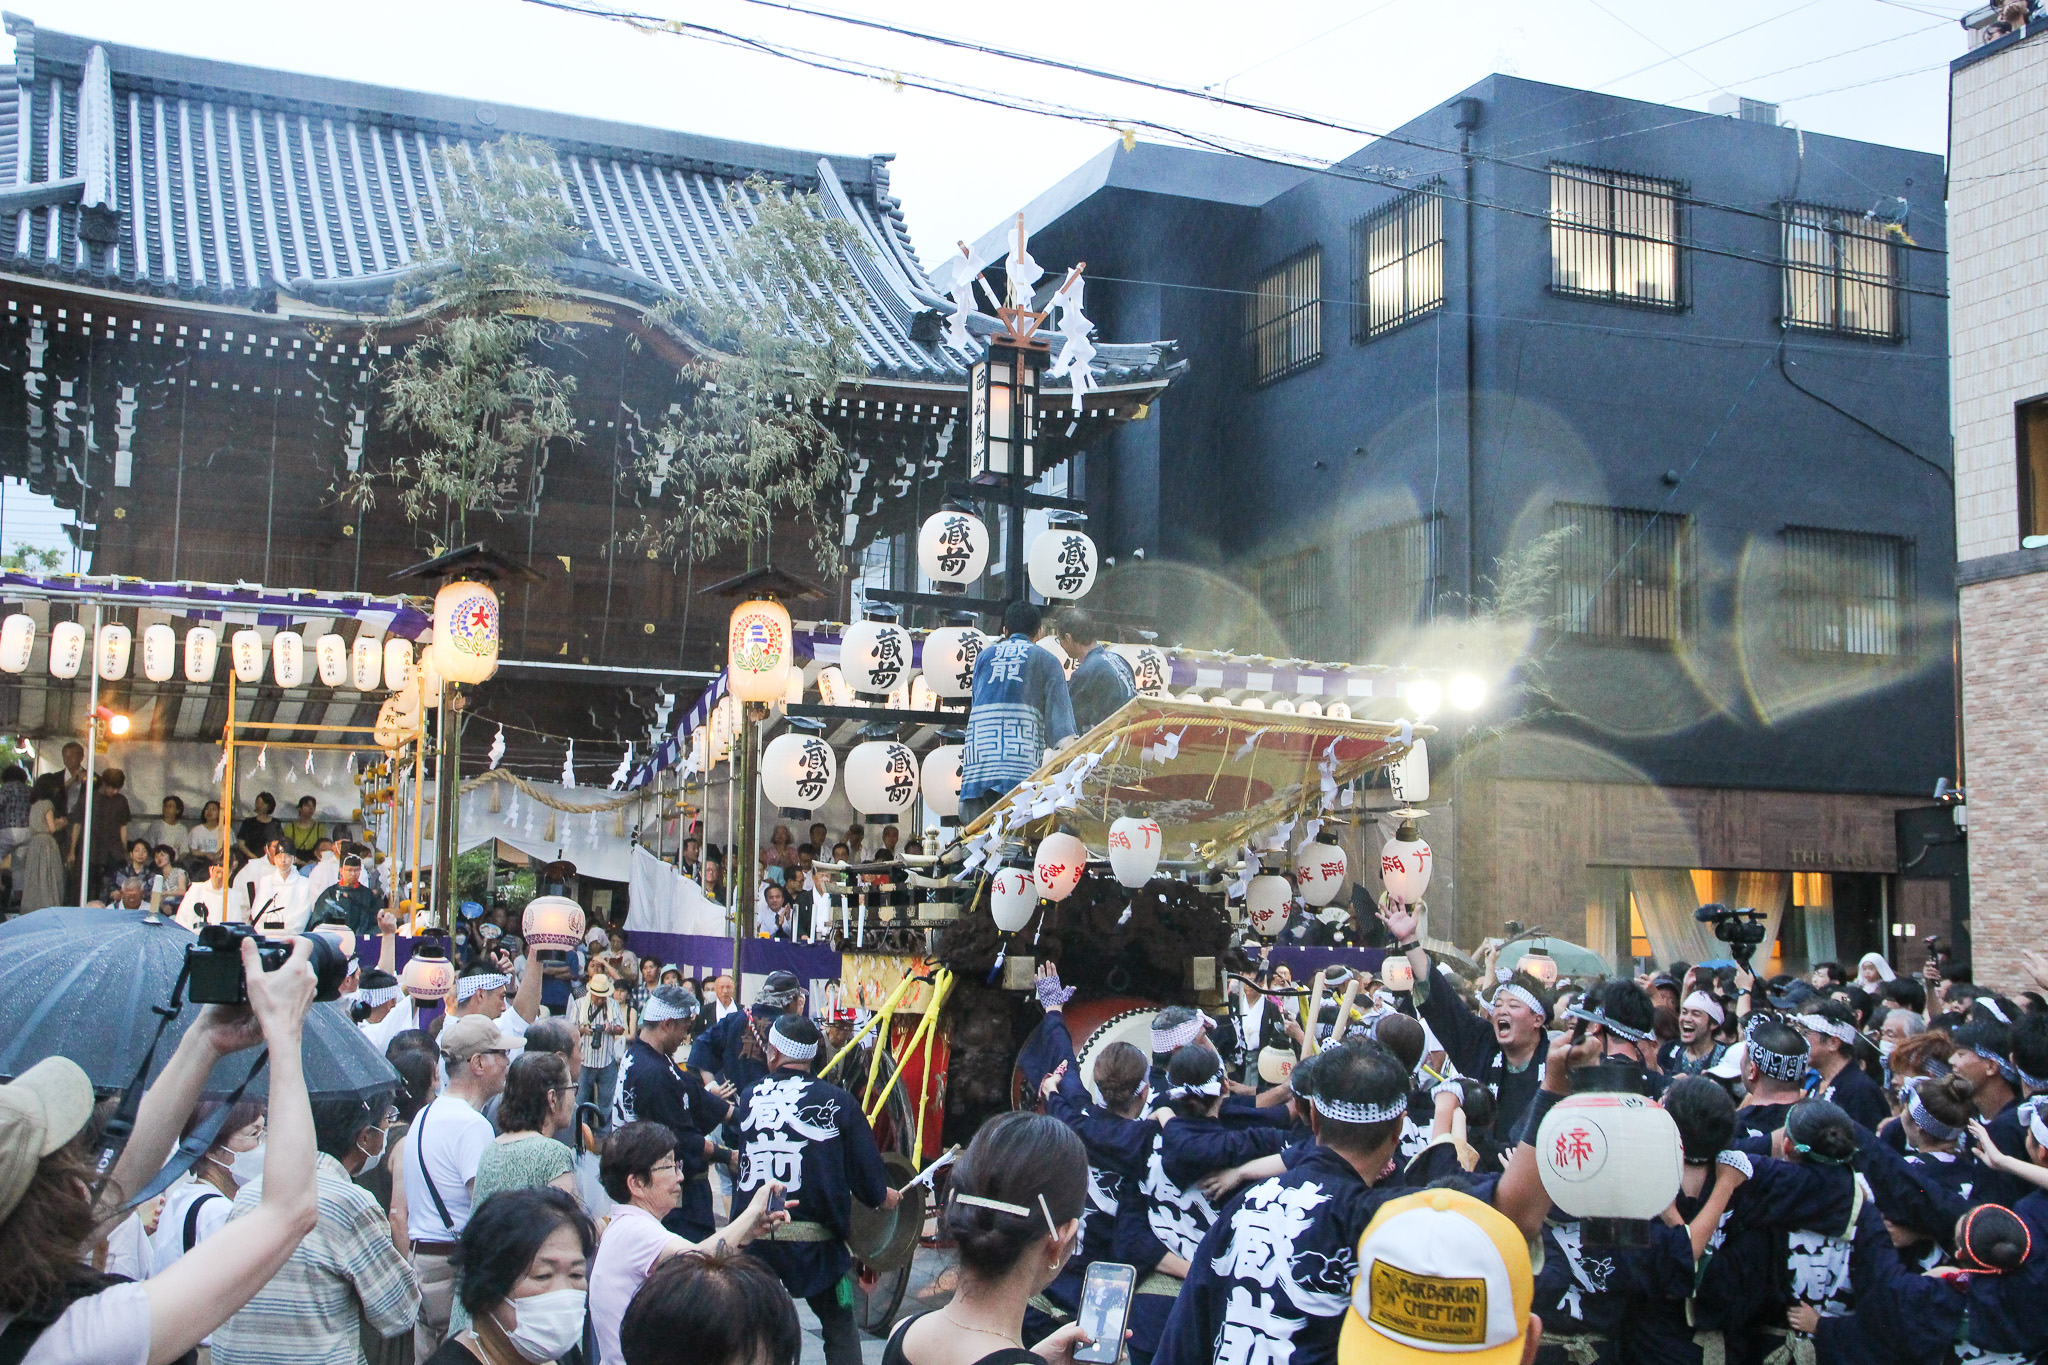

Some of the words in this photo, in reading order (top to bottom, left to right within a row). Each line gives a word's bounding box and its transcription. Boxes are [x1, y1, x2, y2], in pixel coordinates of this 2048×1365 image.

[937, 515, 974, 577] 蔵前
[1055, 535, 1090, 594] 蔵前
[471, 605, 490, 629] 大
[747, 624, 767, 644] 三
[868, 627, 905, 689] 蔵前
[796, 739, 830, 802] 蔵前
[884, 745, 915, 806] 蔵前
[737, 1075, 841, 1193] 蔵前
[1555, 1127, 1594, 1172] 締
[1400, 1278, 1480, 1304] BARBARIAN
[1403, 1299, 1477, 1323] CHIEFTAIN
